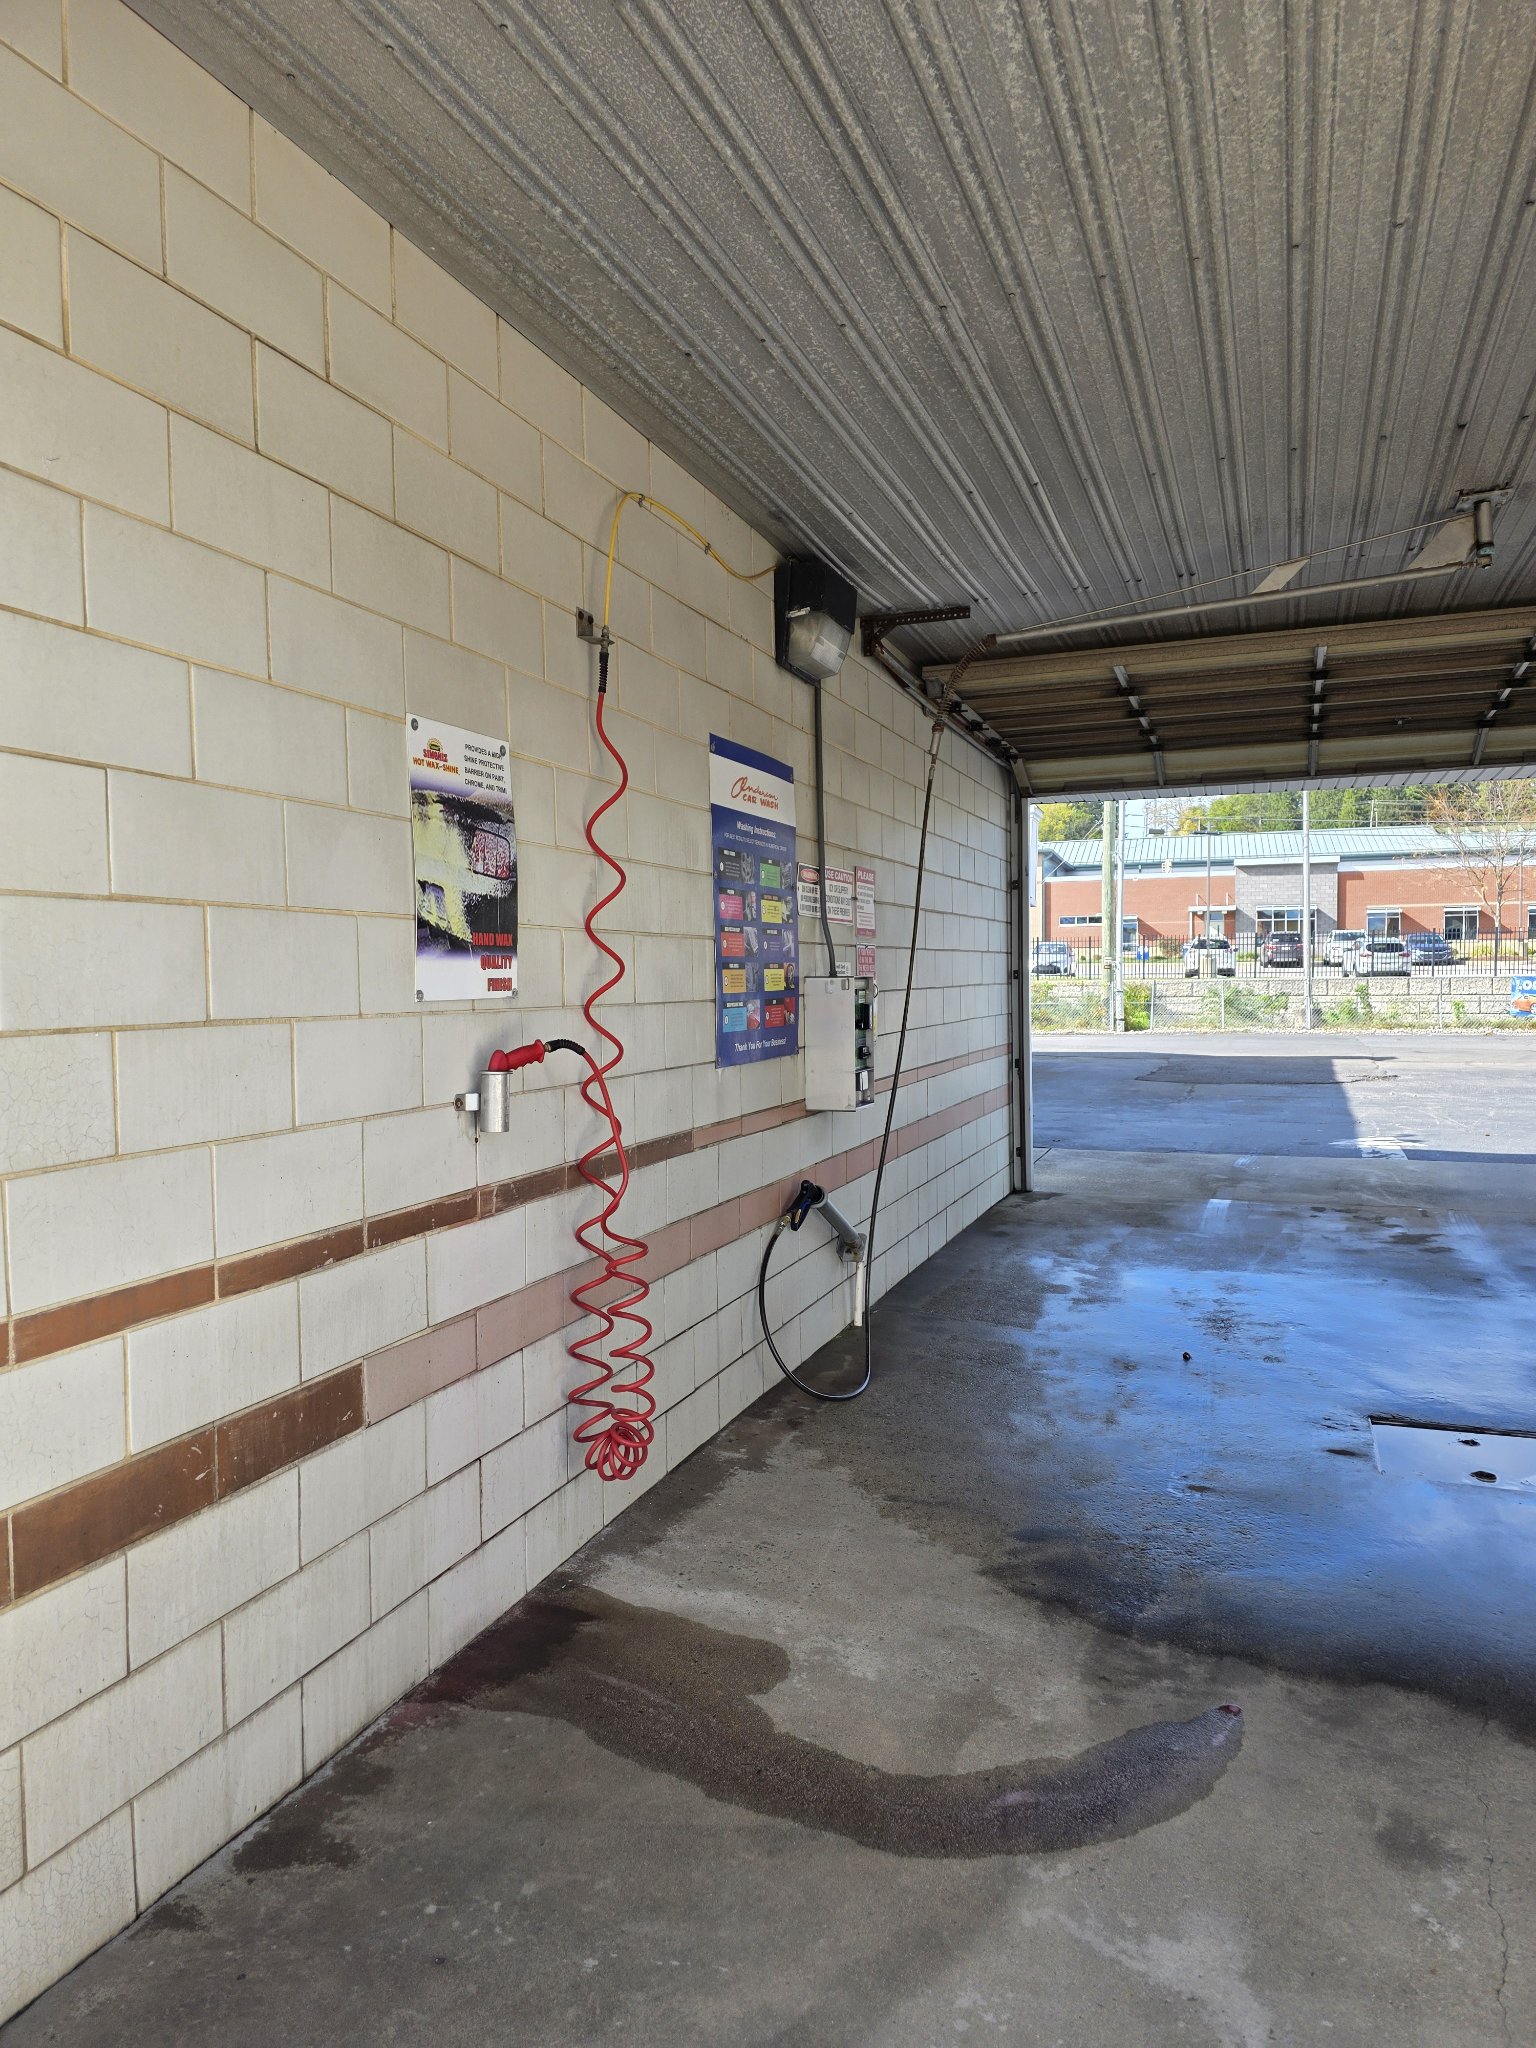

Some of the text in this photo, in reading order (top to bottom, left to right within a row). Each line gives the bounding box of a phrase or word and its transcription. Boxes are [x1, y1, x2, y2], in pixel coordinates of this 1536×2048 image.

[423, 749, 448, 762] SIMONIZ
[464, 743, 487, 756] PROVIDES
[412, 756, 425, 767] HOT
[464, 754, 505, 772] SHINE PROTECTIVE
[464, 766, 484, 778] BARRIER
[484, 772, 492, 780] ON
[486, 783, 495, 791] AND
[742, 793, 779, 810] CAR WASH
[736, 820, 754, 835] Washing
[834, 872, 852, 883] CAUTION
[857, 870, 874, 882] PLEASE
[472, 932, 513, 947] HAND WAX
[481, 955, 512, 970] QUALITY
[735, 1043, 747, 1052] Thank
[762, 1039, 771, 1048] Your
